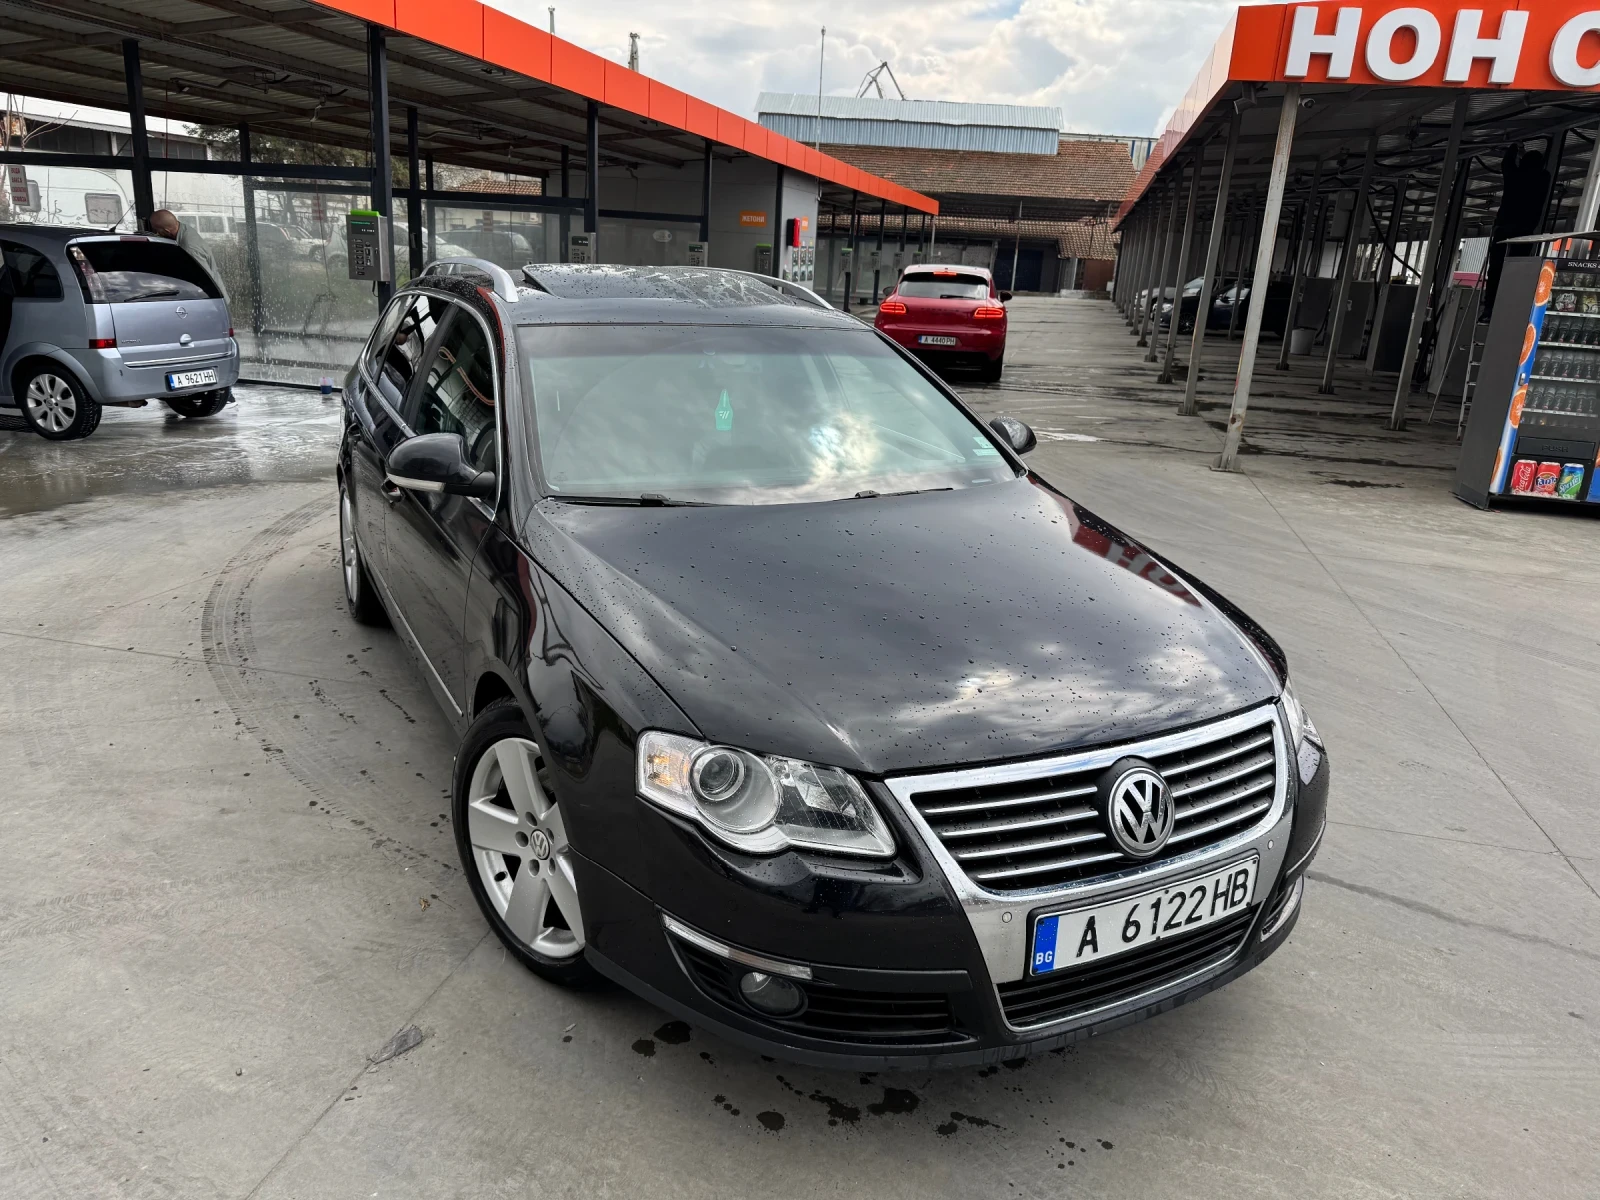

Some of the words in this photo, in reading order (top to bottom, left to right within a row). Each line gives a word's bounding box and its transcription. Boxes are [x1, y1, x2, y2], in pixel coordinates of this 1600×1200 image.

[1284, 6, 1529, 84] НОН
[741, 215, 765, 223] ЖЕТОНИ
[1567, 261, 1598, 269] SNACKS
[177, 375, 183, 386] A
[185, 371, 215, 385] 9621HH
[1559, 474, 1580, 493] Sprite
[1075, 915, 1099, 958] A
[1121, 867, 1250, 943] 6122HB
[1035, 950, 1053, 965] BG
